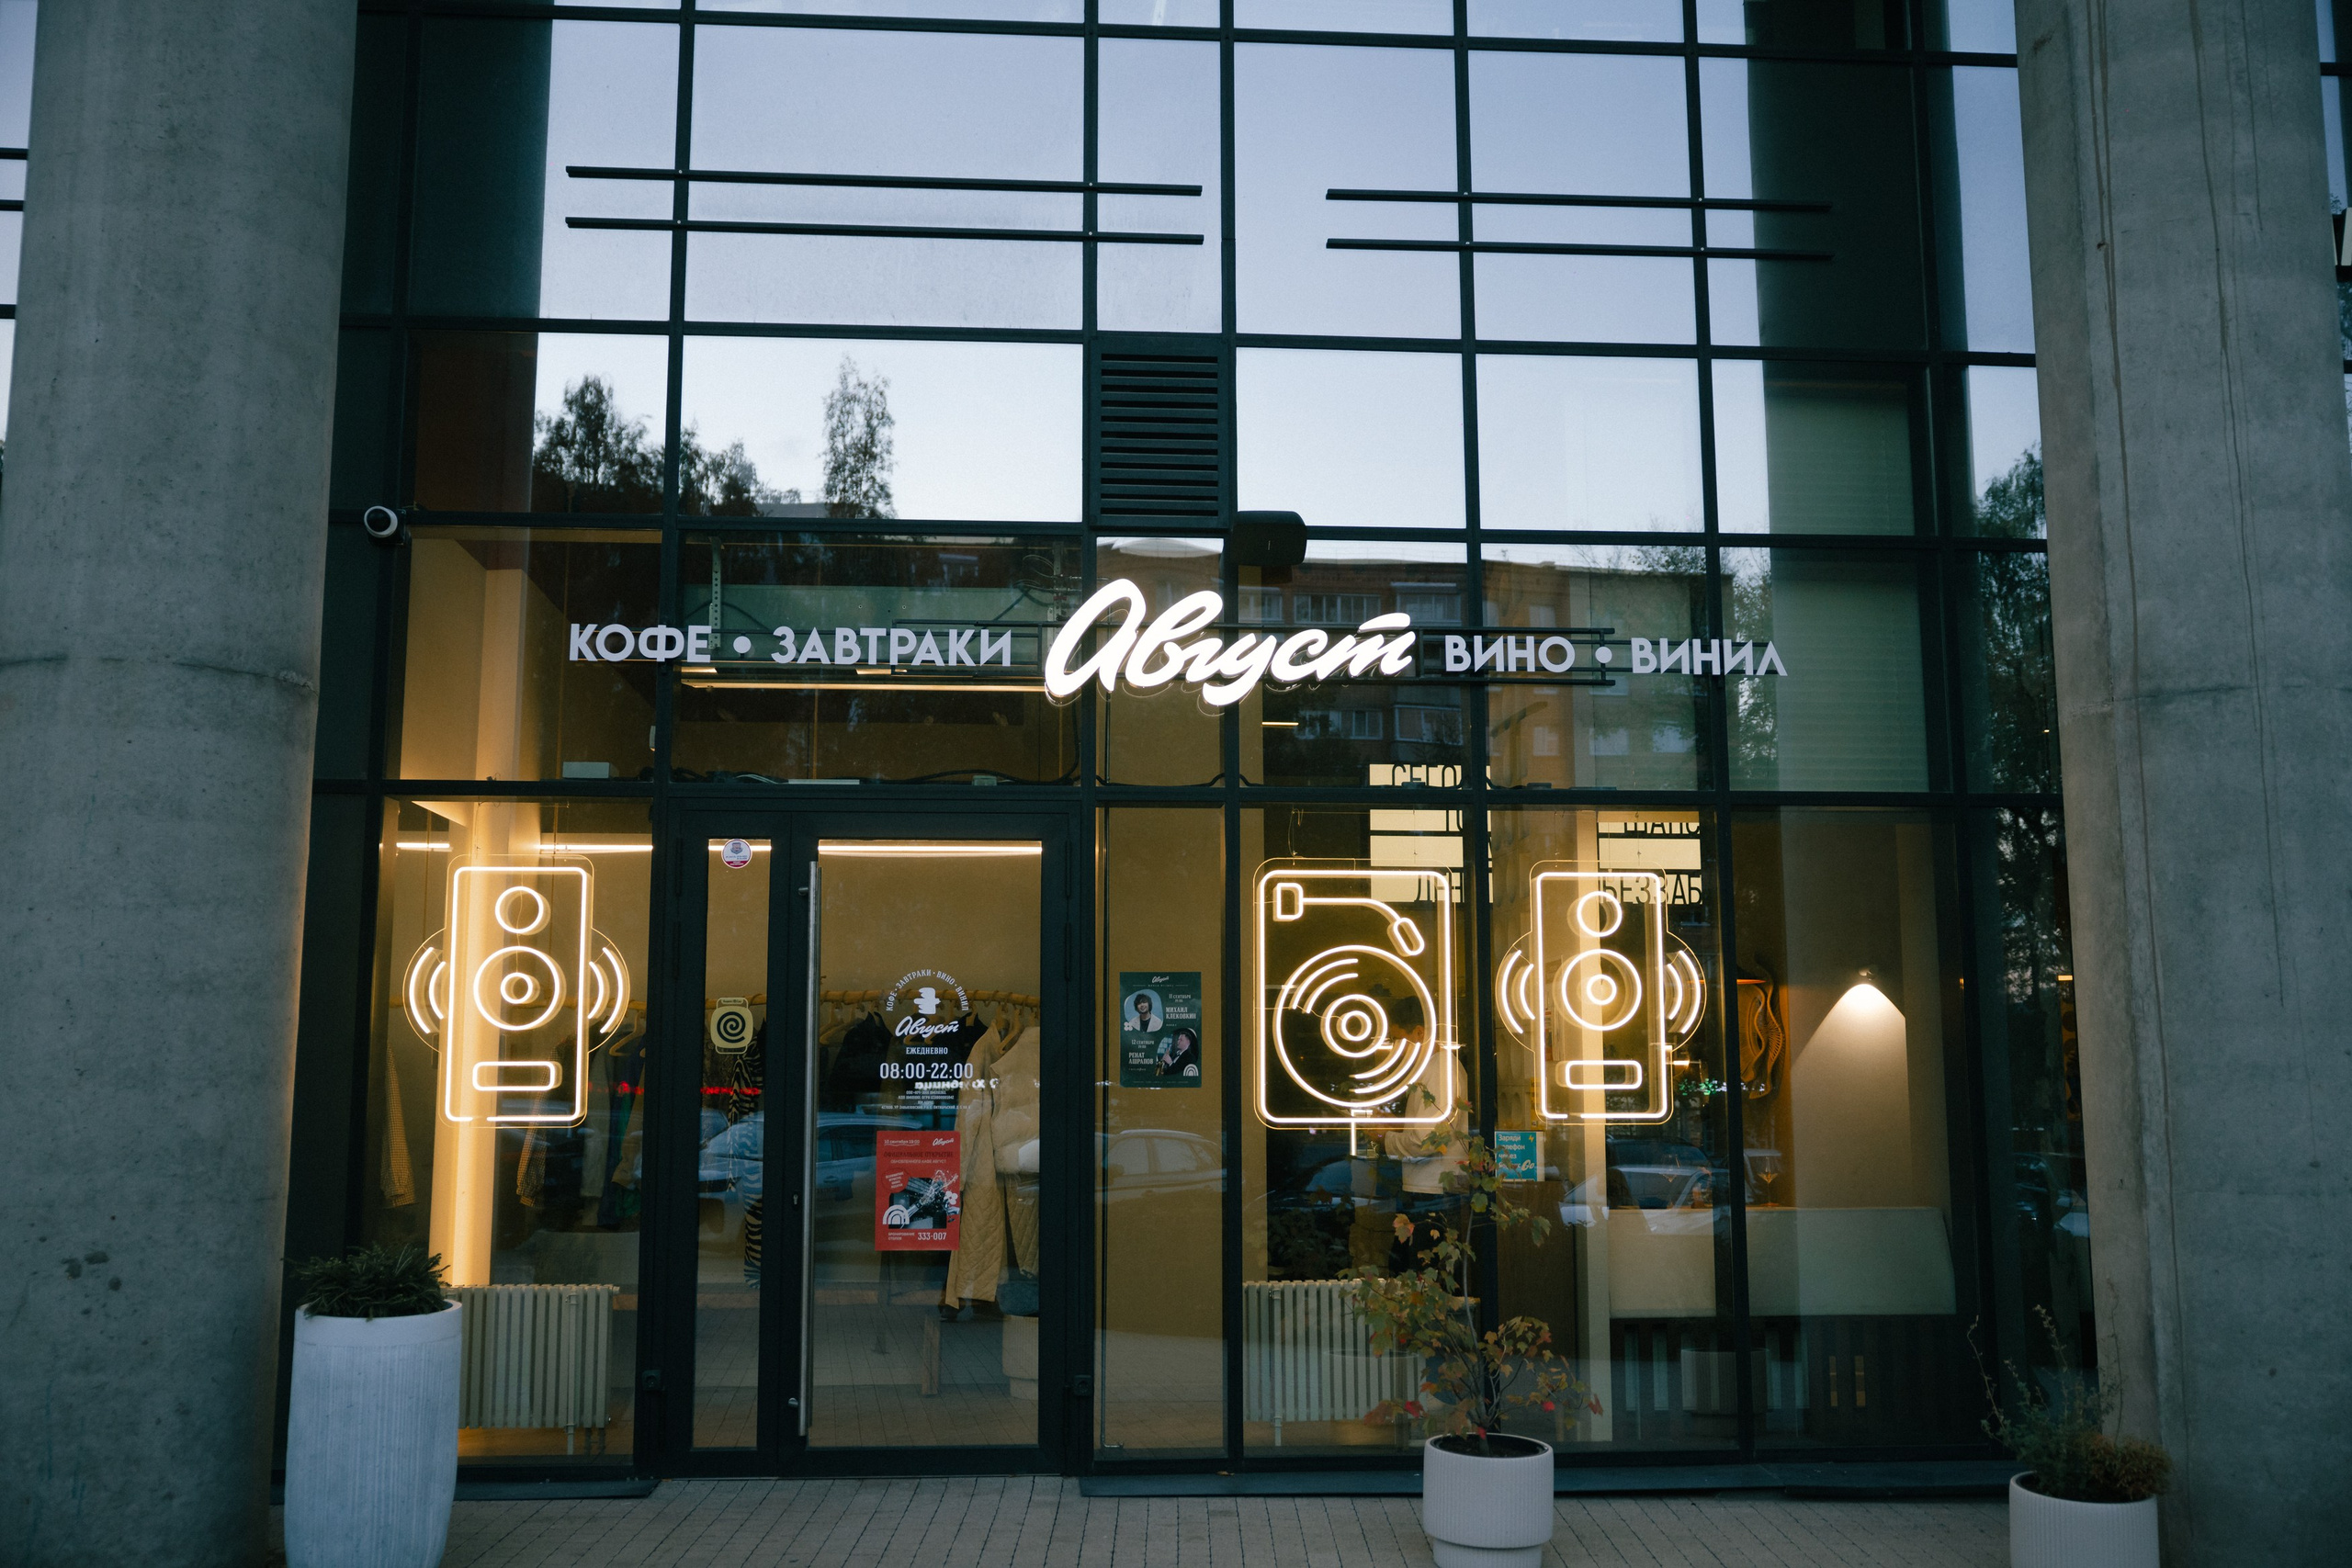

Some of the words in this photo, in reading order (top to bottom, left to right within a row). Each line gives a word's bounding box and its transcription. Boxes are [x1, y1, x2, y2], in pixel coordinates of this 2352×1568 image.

[569, 623, 712, 663] КОФЕ
[770, 626, 1012, 667] ЗАВТРАКИ
[1044, 578, 1417, 706] Август
[1444, 635, 1576, 673] ВИНО
[1631, 637, 1788, 677] ВИНИЛ
[886, 990, 898, 1011] КОФЕ
[896, 968, 932, 989] ЗАВТРАКИ
[936, 970, 956, 986] ВИНО
[956, 986, 969, 1011] ВИНИЛ
[895, 1015, 959, 1038] Август
[906, 1047, 948, 1055] ЕЖЕДНЕВНО
[879, 1062, 974, 1079] 08:00-22:00
[1521, 1159, 1535, 1171] Go
[917, 1232, 947, 1241] 333-007
